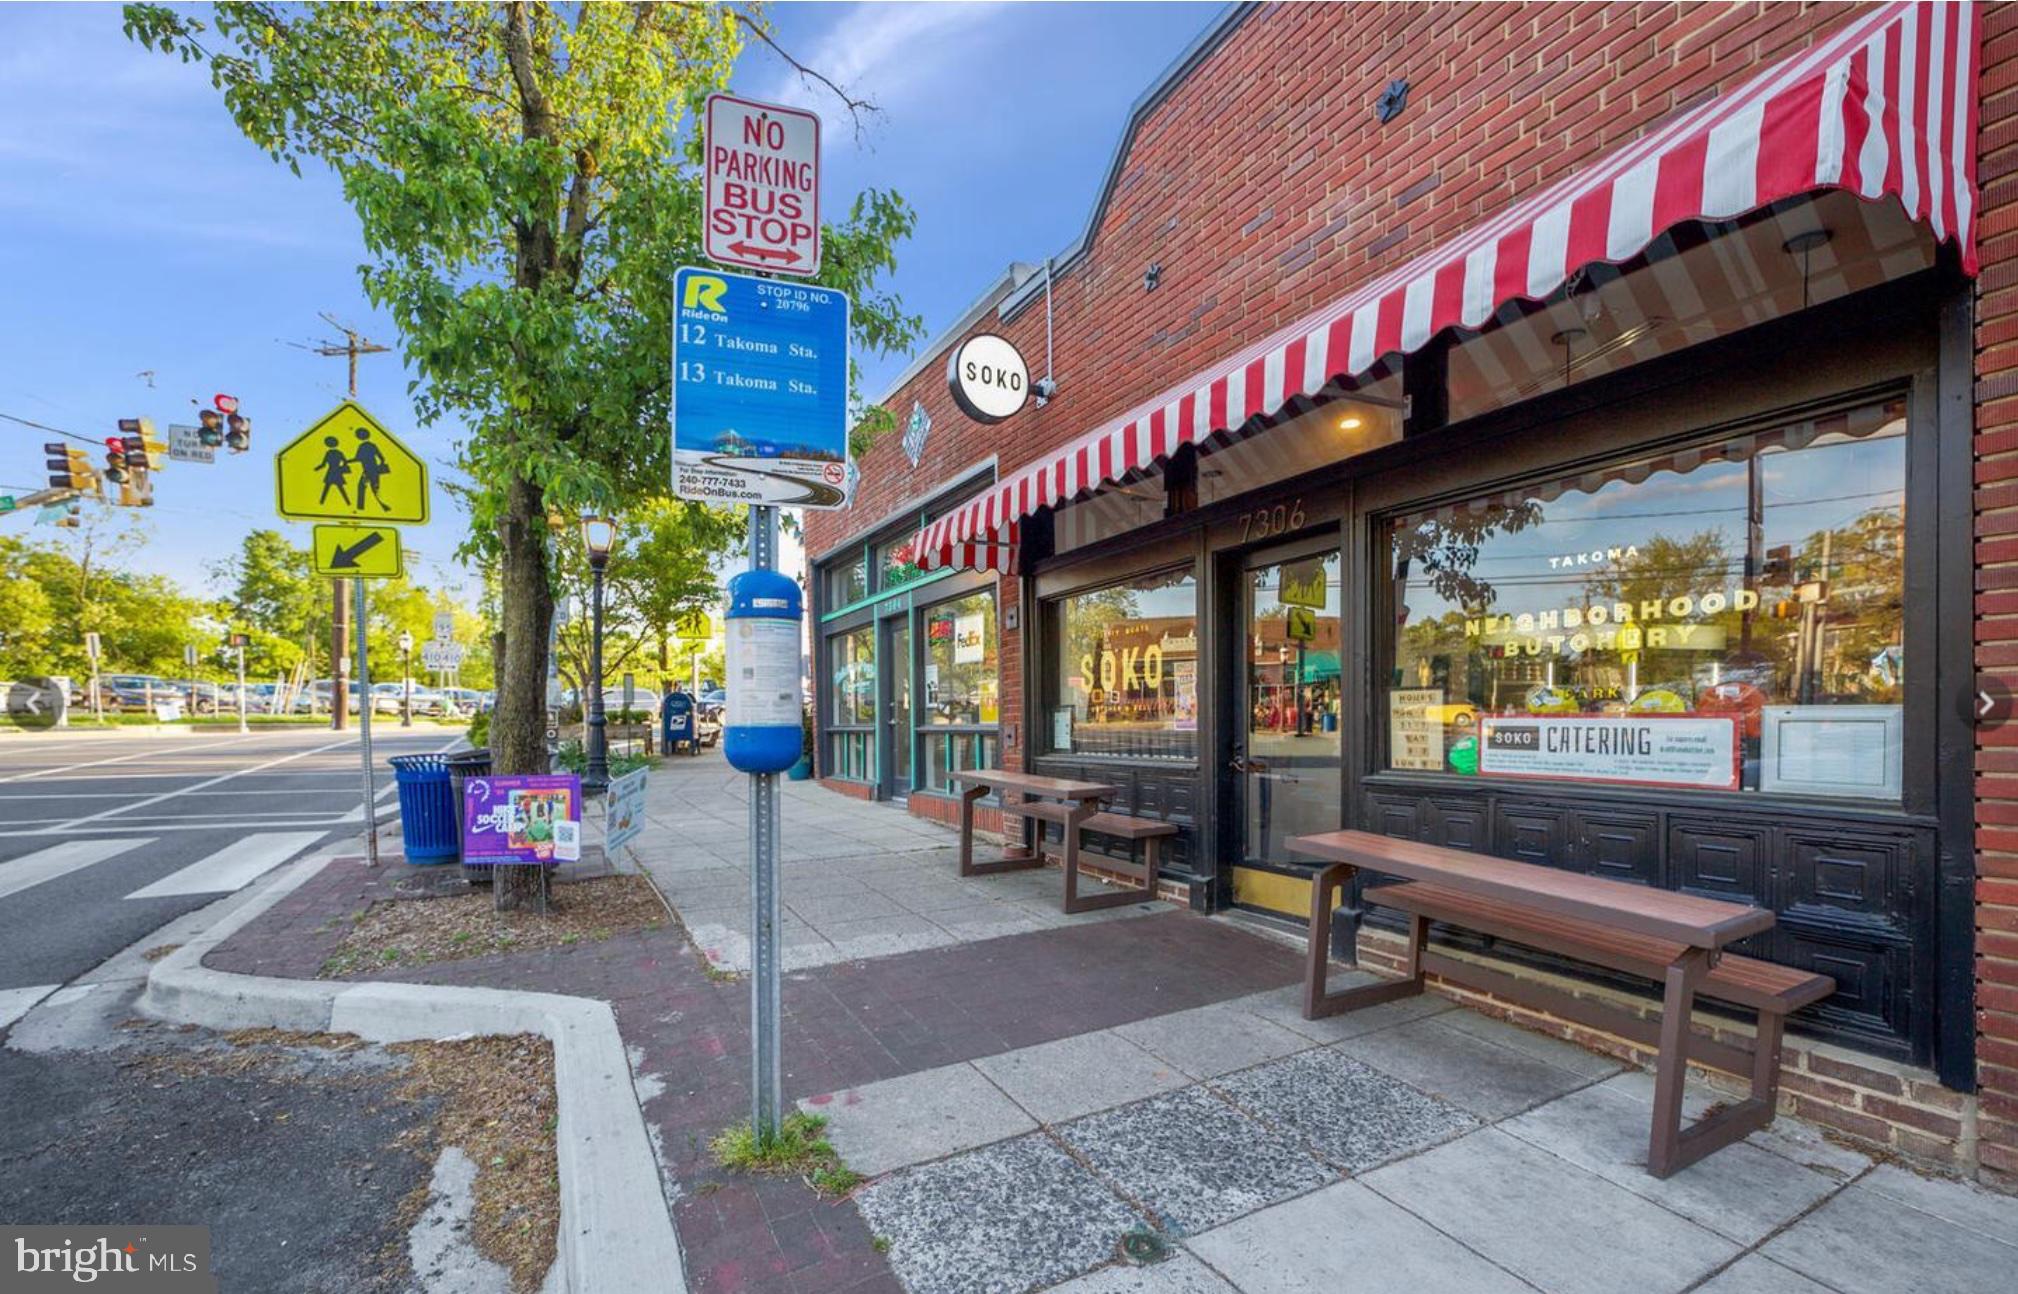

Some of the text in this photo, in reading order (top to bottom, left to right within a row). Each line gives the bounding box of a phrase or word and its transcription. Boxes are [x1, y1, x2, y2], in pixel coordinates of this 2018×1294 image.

[744, 115, 784, 150] NO
[714, 146, 812, 192] PARKING
[724, 182, 801, 219] BUS
[712, 208, 812, 246] STOP
[757, 284, 832, 304] STOP ID NO.
[776, 299, 810, 312] 20796
[680, 324, 818, 359] 12 Takoma Sta.
[680, 362, 817, 394] 13 Takoma Sta.
[966, 361, 1021, 391] SOKO
[679, 474, 746, 488] 240-777-7433
[679, 486, 762, 500] RideOnBus.com
[1239, 500, 1306, 543] 7306
[1549, 545, 1638, 569] TAKOMA
[1465, 590, 1758, 636] NEIGHBORHOOD
[957, 630, 980, 648] FedEx
[1081, 644, 1163, 694] SOKO
[1495, 726, 1651, 755] SOKO CATERING
